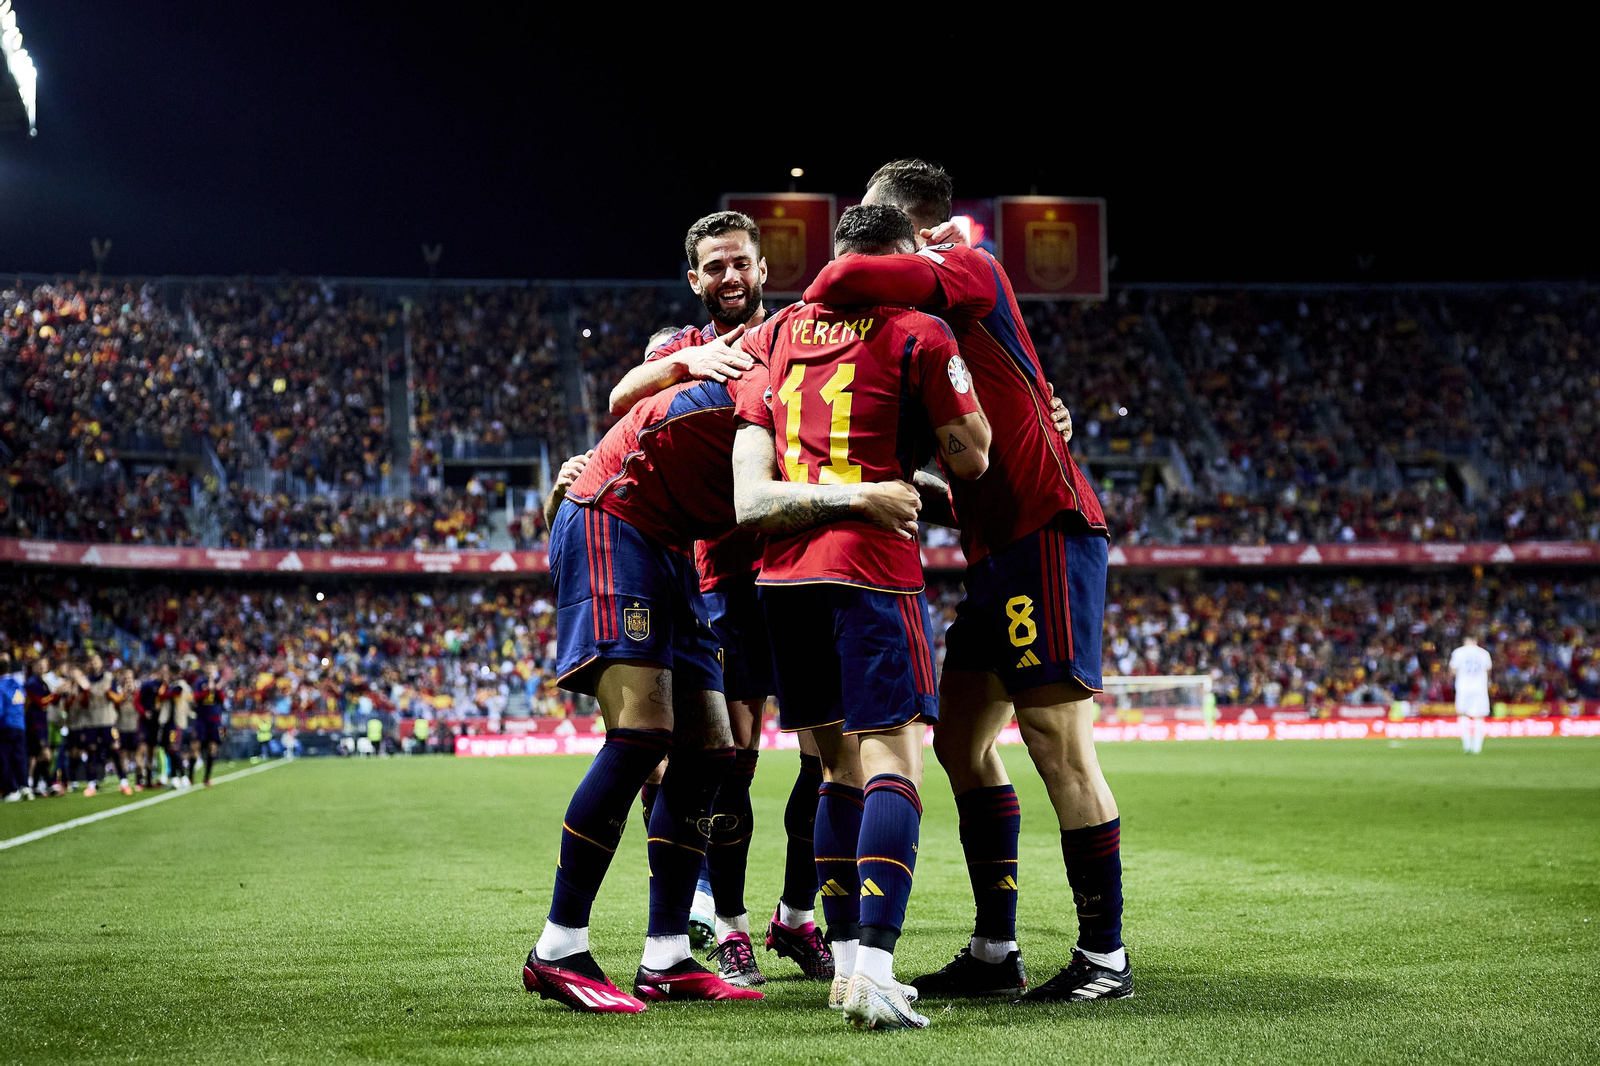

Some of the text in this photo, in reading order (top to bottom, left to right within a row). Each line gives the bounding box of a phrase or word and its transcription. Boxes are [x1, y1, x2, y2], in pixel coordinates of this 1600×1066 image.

[791, 318, 874, 345] YEREMY
[777, 363, 862, 484] 11
[1005, 595, 1037, 647] 8
